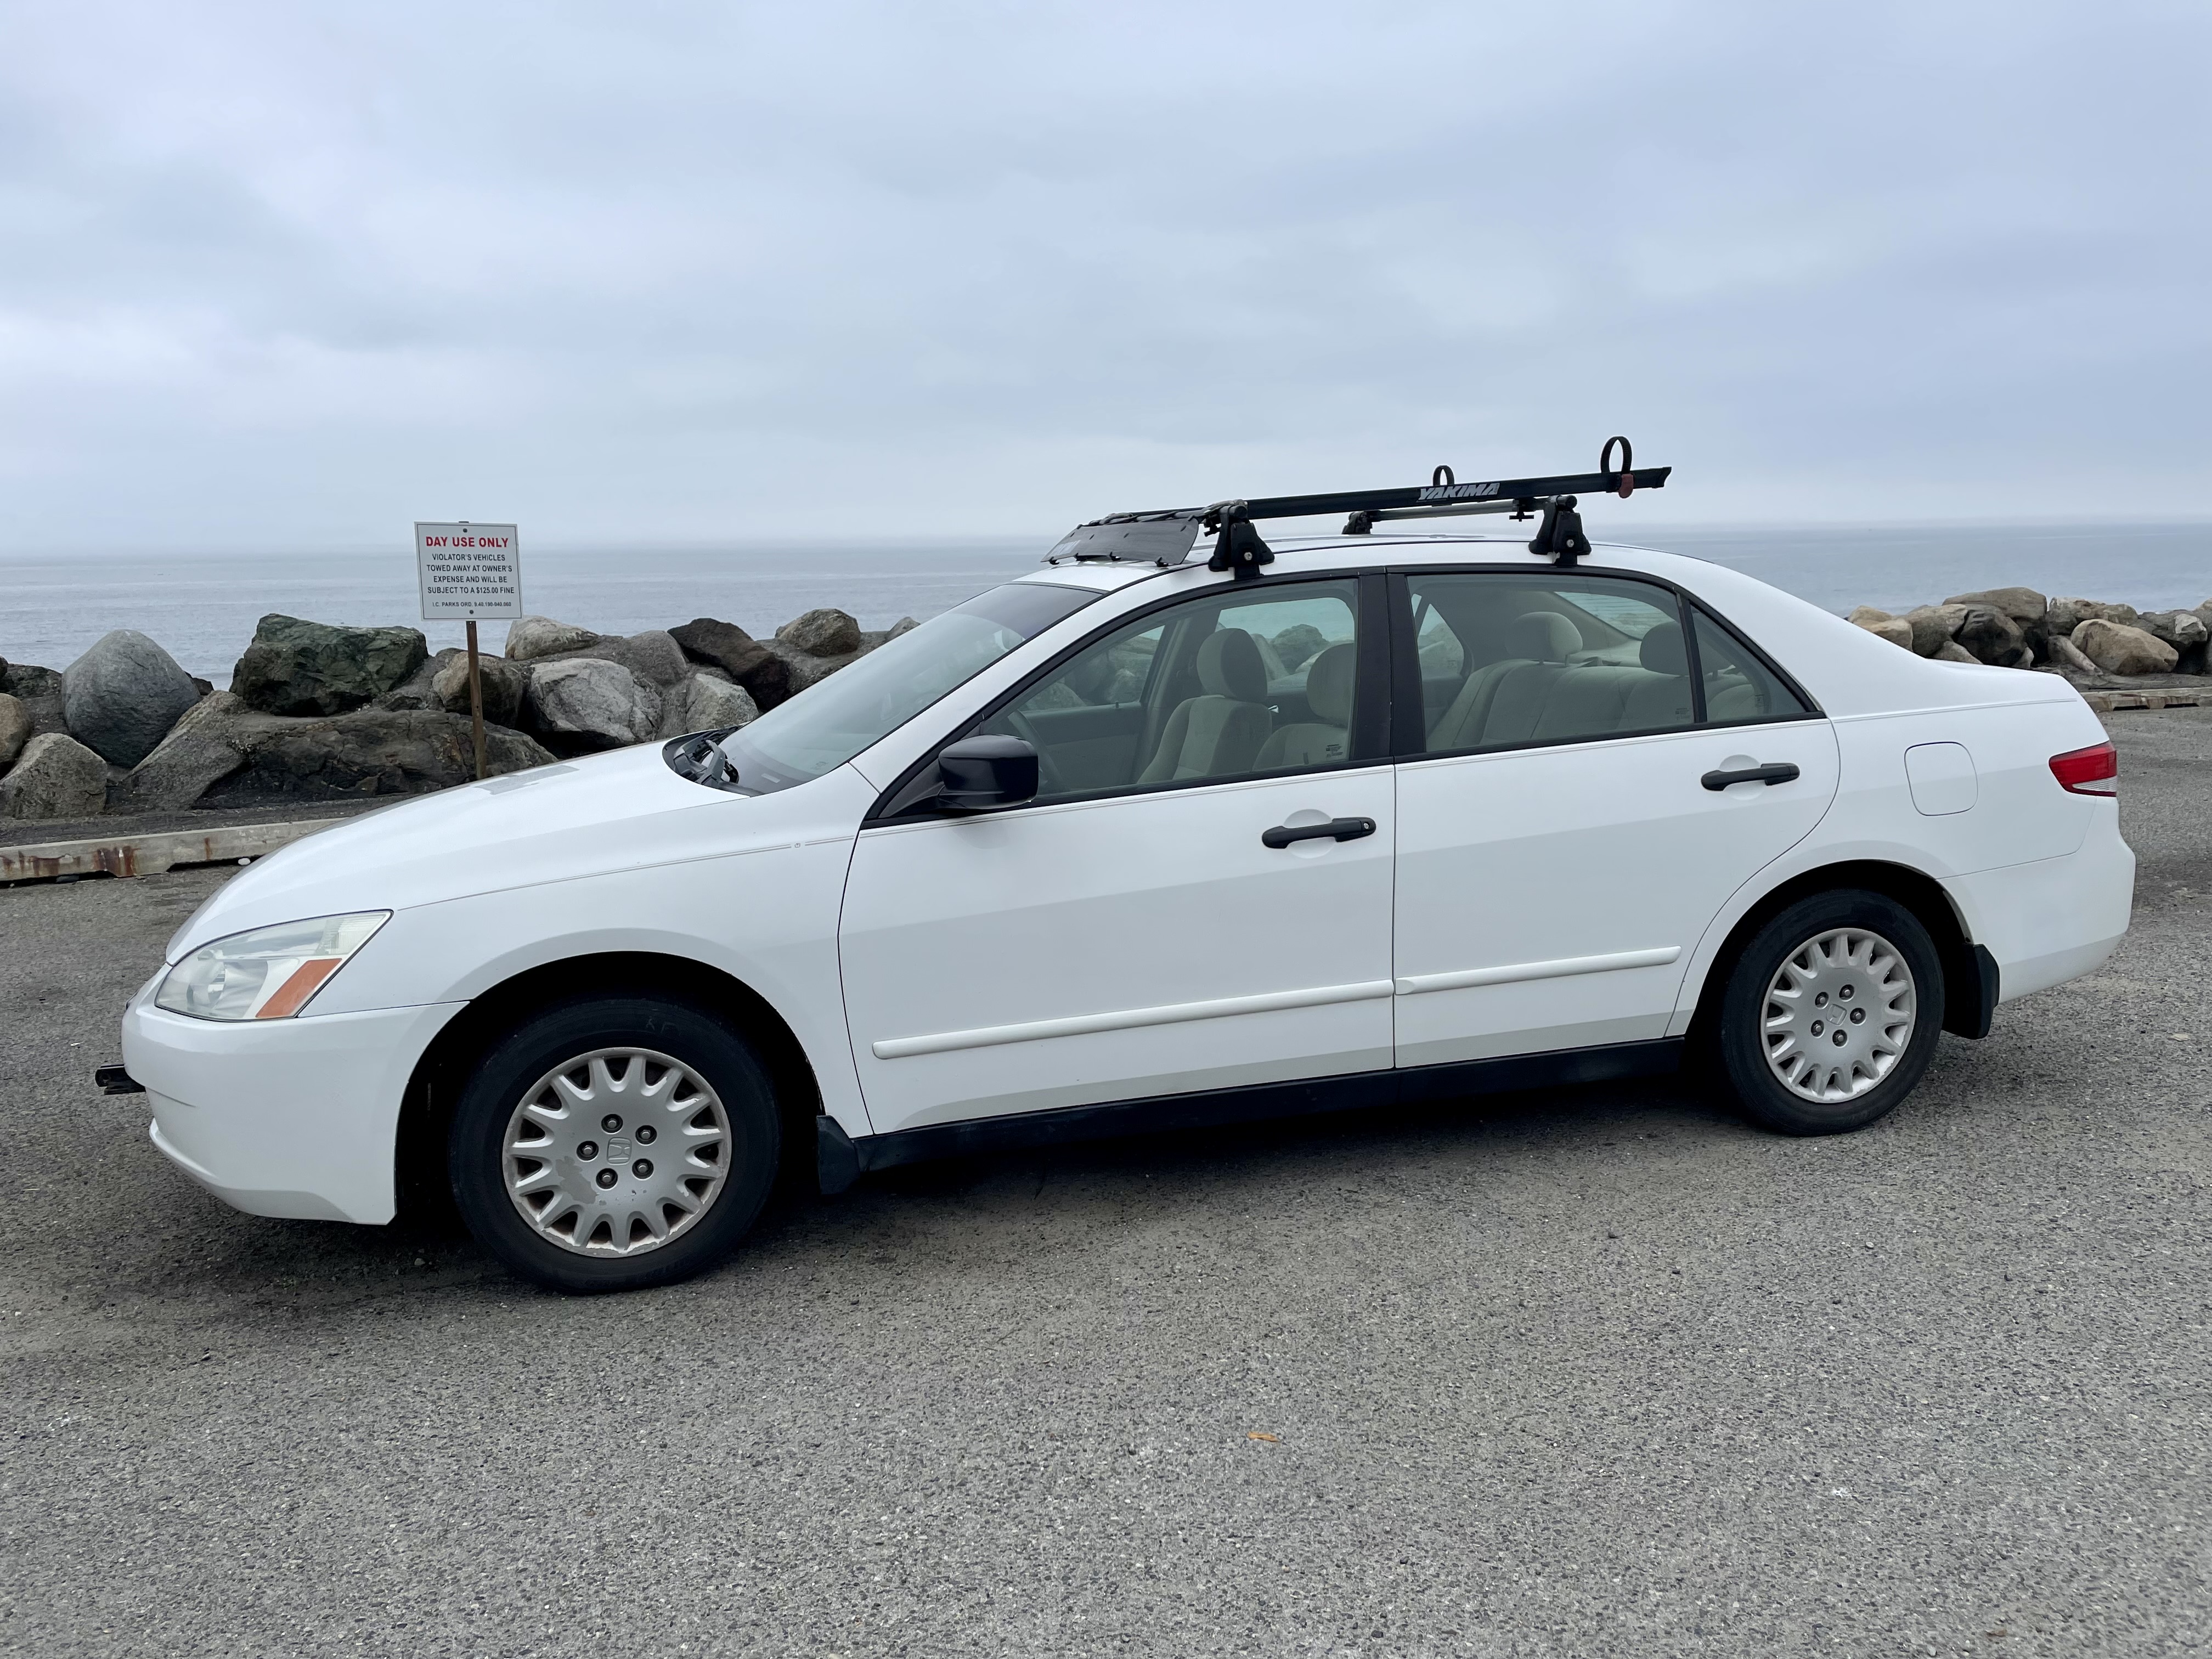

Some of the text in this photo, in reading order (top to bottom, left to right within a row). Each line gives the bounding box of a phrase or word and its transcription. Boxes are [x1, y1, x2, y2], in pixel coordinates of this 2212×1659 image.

[1418, 483, 1500, 500] YAKIMA
[425, 536, 509, 548] DAY USE ONLY
